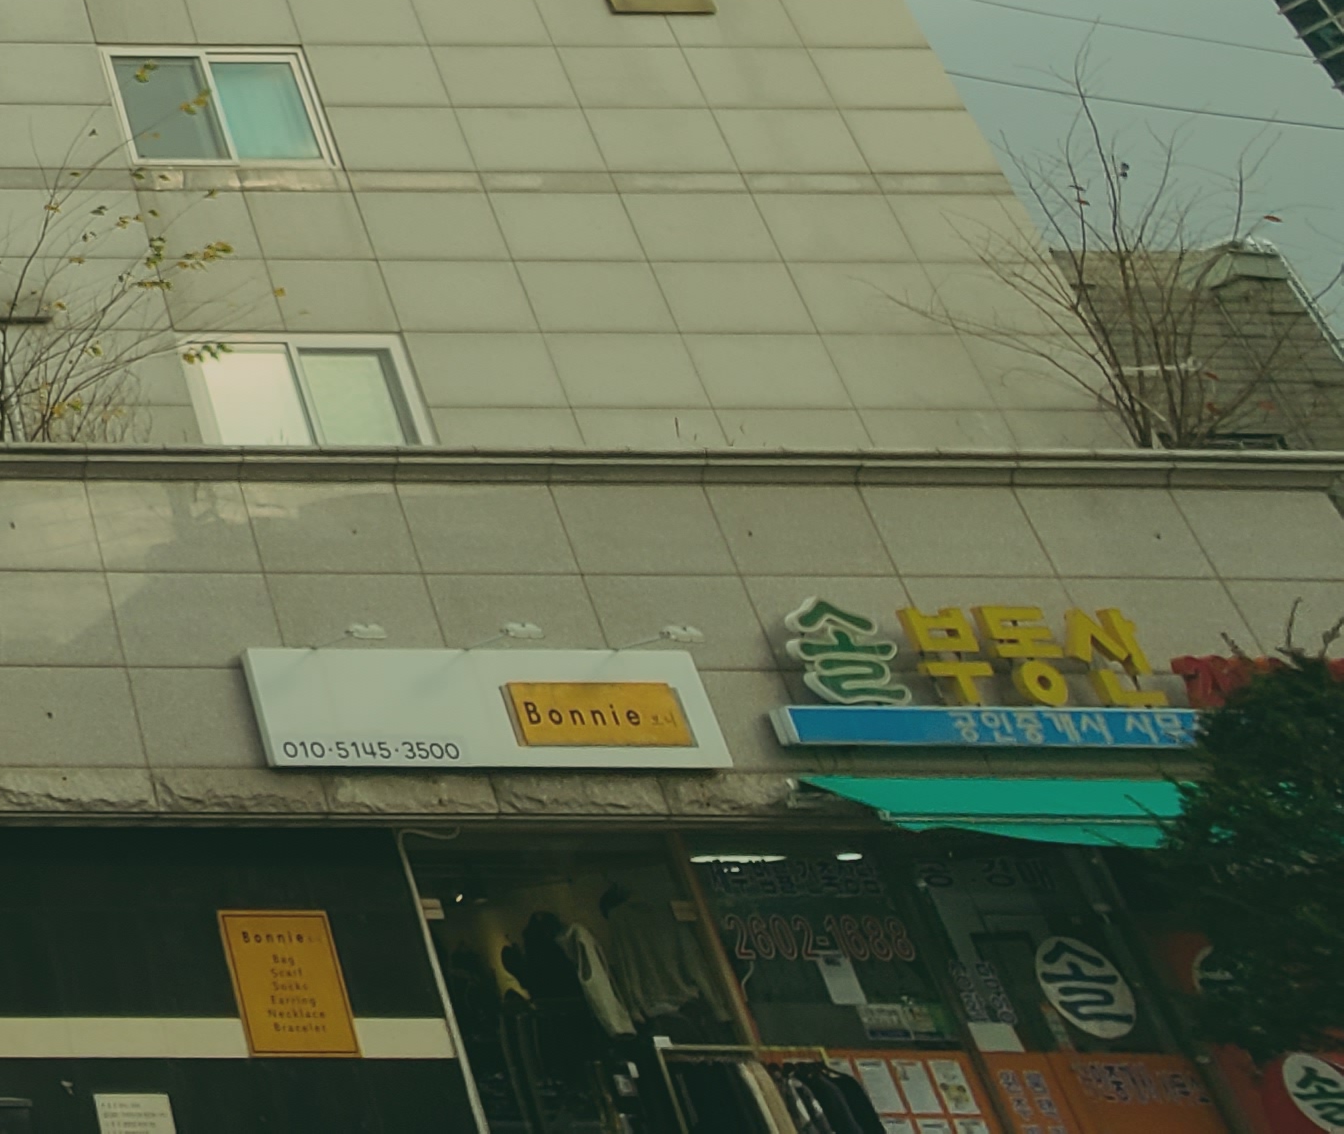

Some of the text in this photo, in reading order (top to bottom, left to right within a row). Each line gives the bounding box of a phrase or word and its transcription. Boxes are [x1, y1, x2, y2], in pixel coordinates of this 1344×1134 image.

[898, 605, 1170, 708] 부동산
[524, 701, 641, 726] Bonnie
[948, 711, 1114, 745] 공인중개사
[241, 930, 304, 944] Bonnie
[725, 913, 916, 962] 2602-1688
[272, 954, 295, 966] Bag
